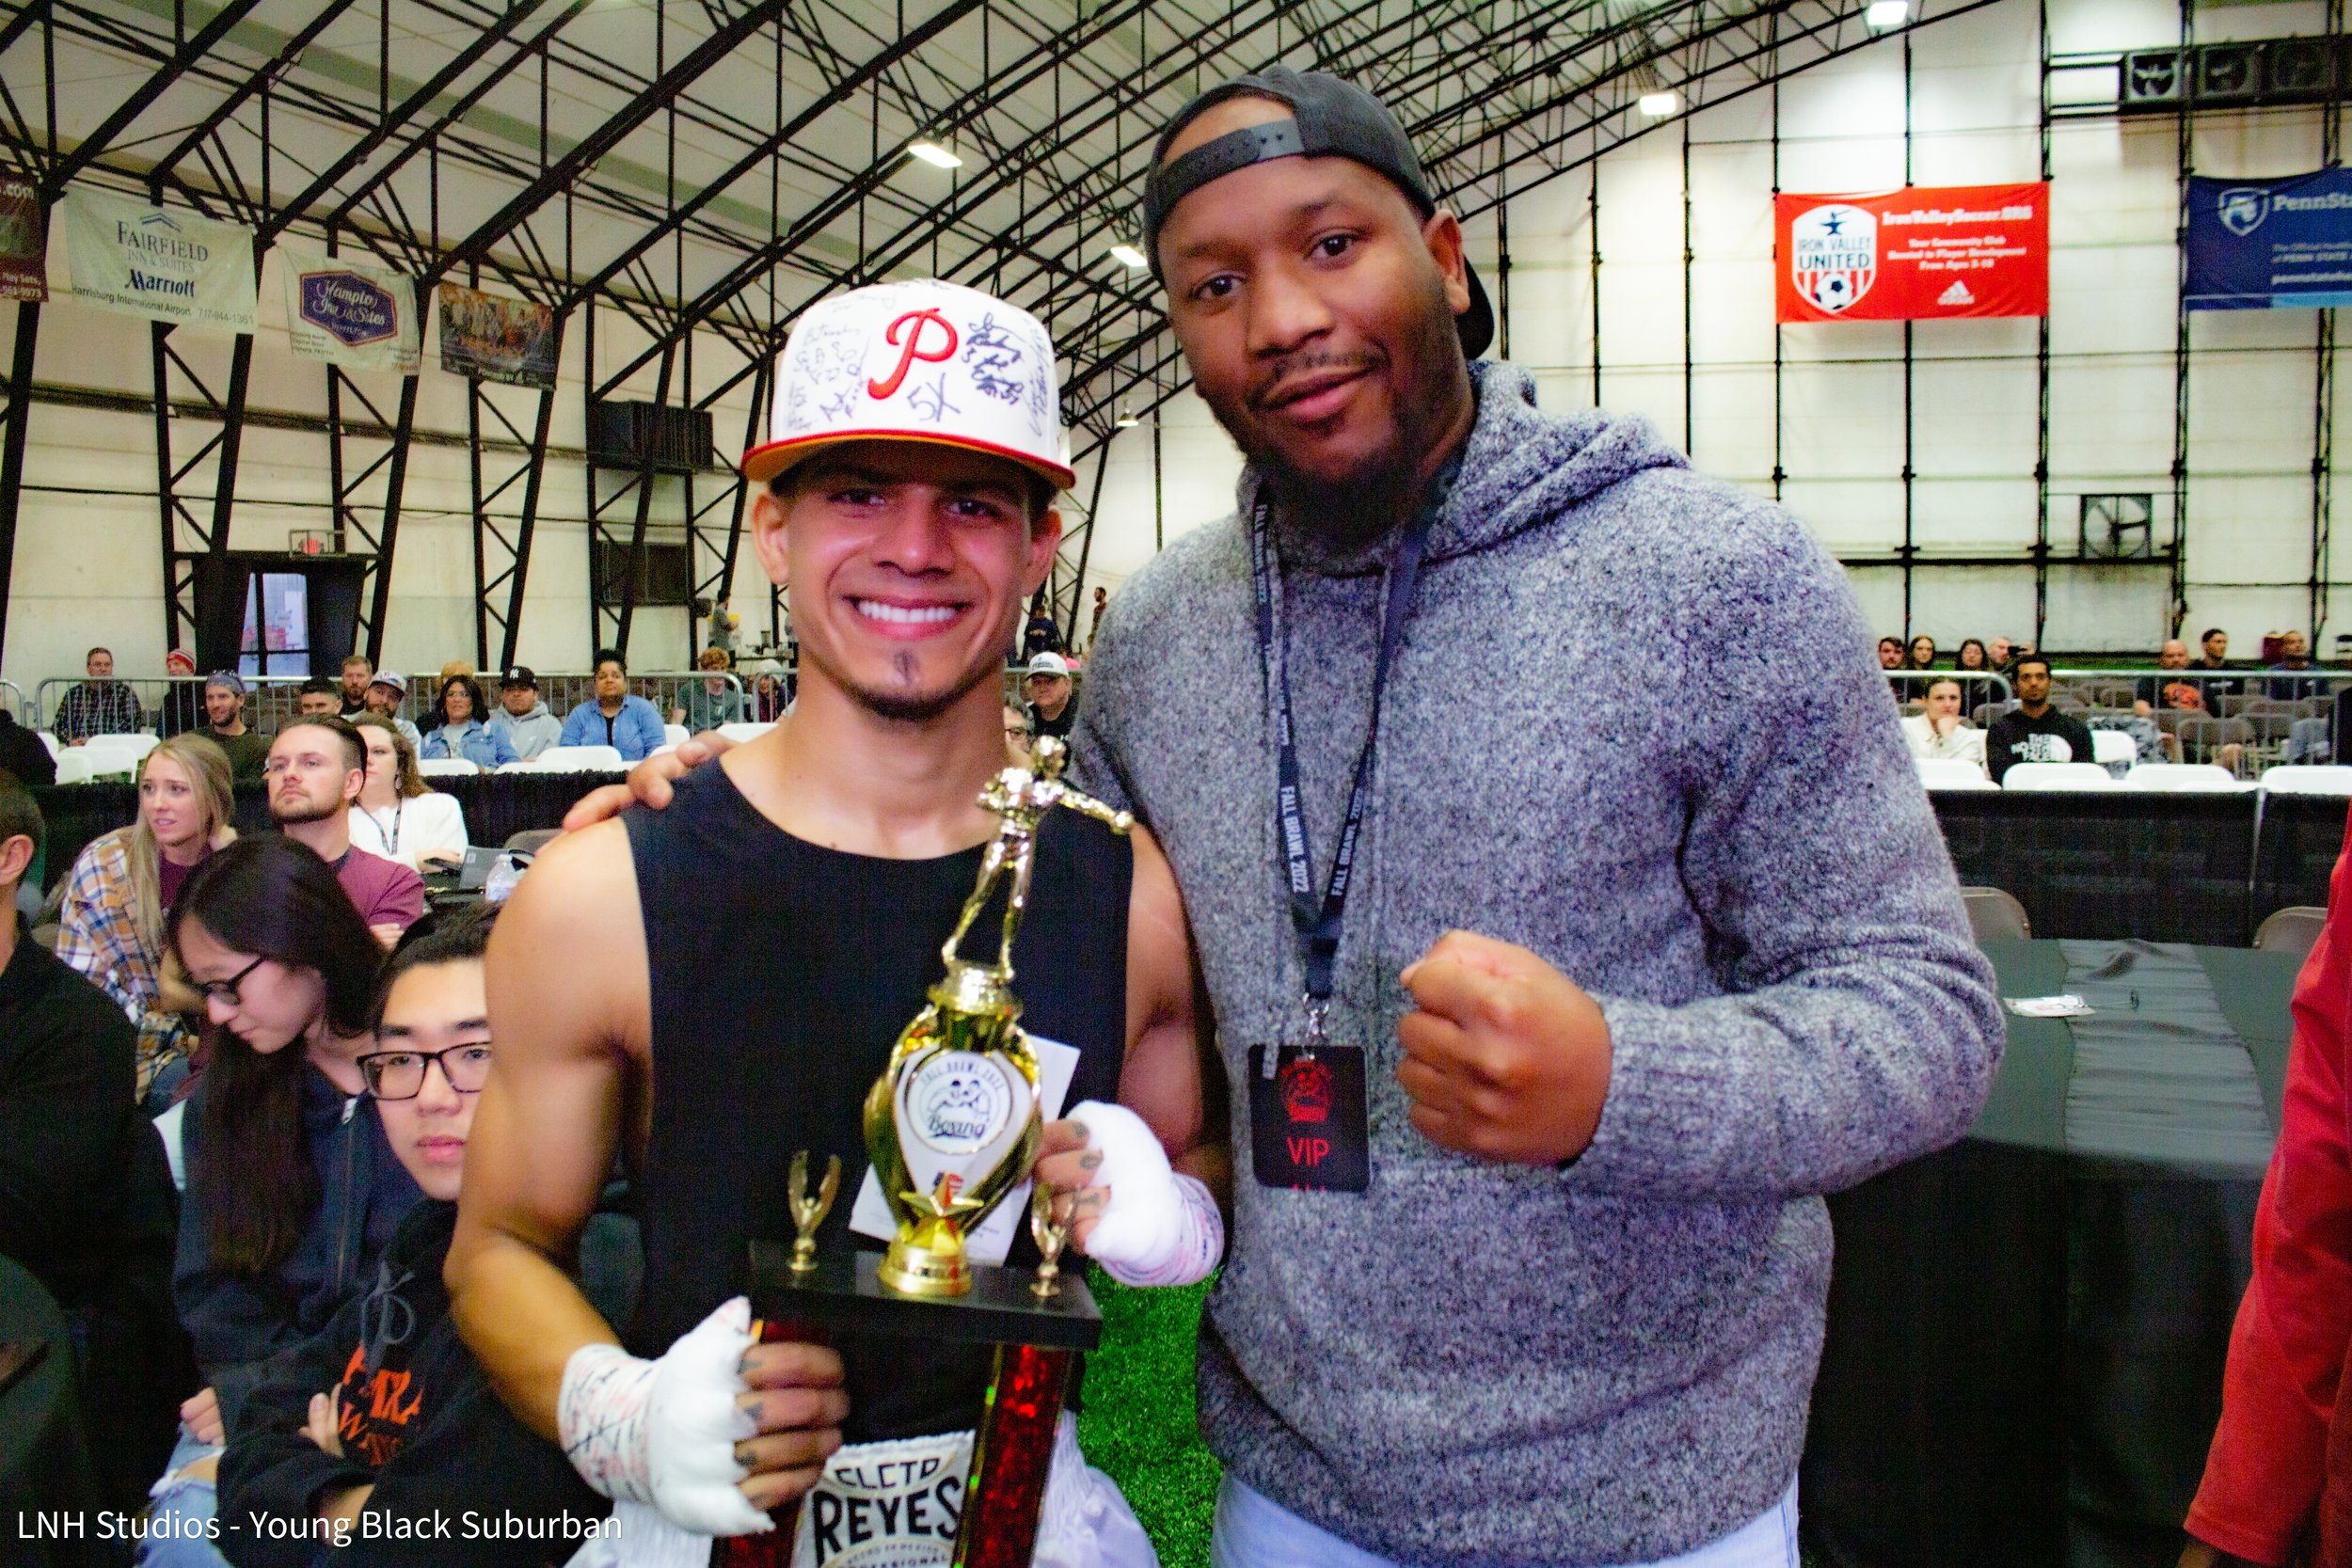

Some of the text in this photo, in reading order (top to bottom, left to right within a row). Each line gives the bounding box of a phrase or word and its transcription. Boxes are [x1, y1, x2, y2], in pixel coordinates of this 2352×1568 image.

[117, 220, 209, 262] FAIRFIELD
[1798, 236, 1870, 252] IRON VALLEY
[1968, 246, 2027, 258] Development
[128, 249, 195, 273] INN & SUITES
[1799, 252, 1870, 270] UNITED
[124, 268, 195, 299] Marriott
[72, 284, 115, 304] Harrisburg
[117, 294, 164, 312] International
[165, 304, 191, 318] Airport
[867, 307, 959, 401] P
[1280, 785, 1310, 894] FALL BRAWL 2022
[1338, 822, 1358, 865] BRAWL
[1330, 867, 1348, 896] FALL
[928, 1113, 986, 1140] Boxing
[1286, 1135, 1330, 1167] VIP
[812, 1476, 961, 1568] REYES
